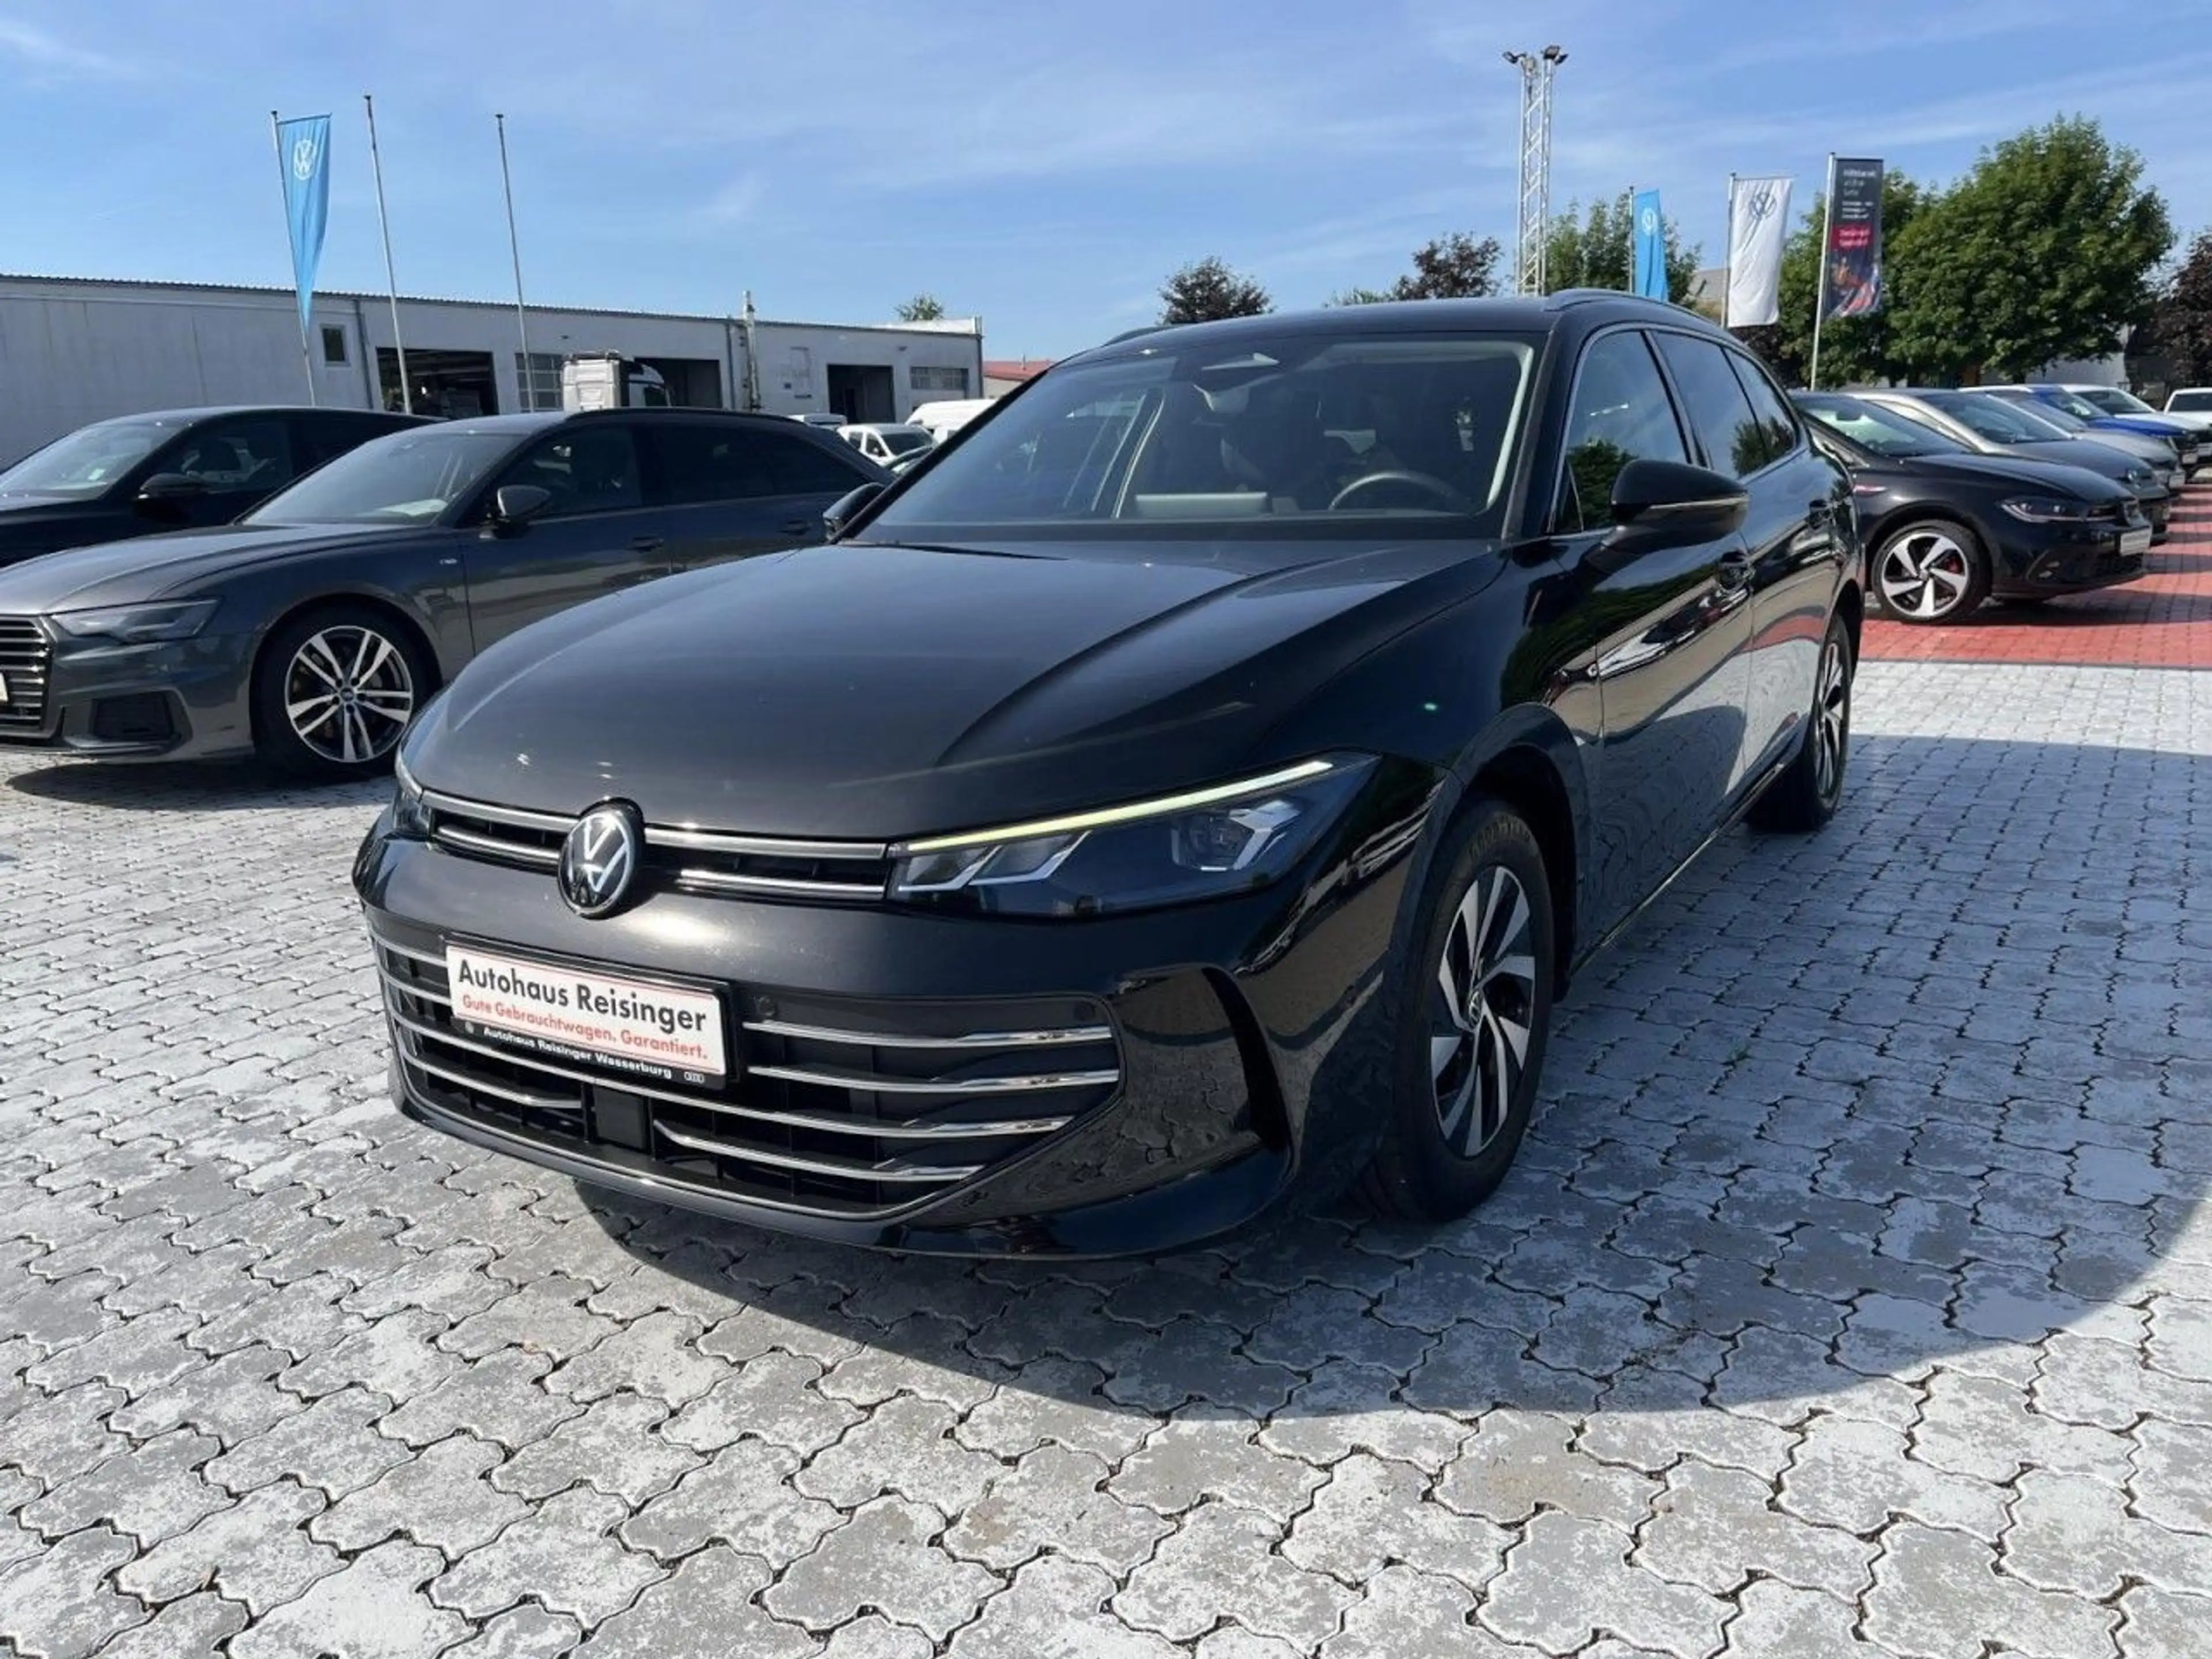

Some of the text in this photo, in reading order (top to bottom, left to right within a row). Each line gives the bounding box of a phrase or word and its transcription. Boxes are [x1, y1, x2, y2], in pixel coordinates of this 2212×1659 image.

[567, 812, 630, 911] VW
[459, 959, 706, 1035] Autohaus Reisinger
[463, 994, 708, 1059] Gute Gebrauchtwagen. Garantiert.
[483, 1027, 672, 1080] Autohaus Reisinger Wasserburg
